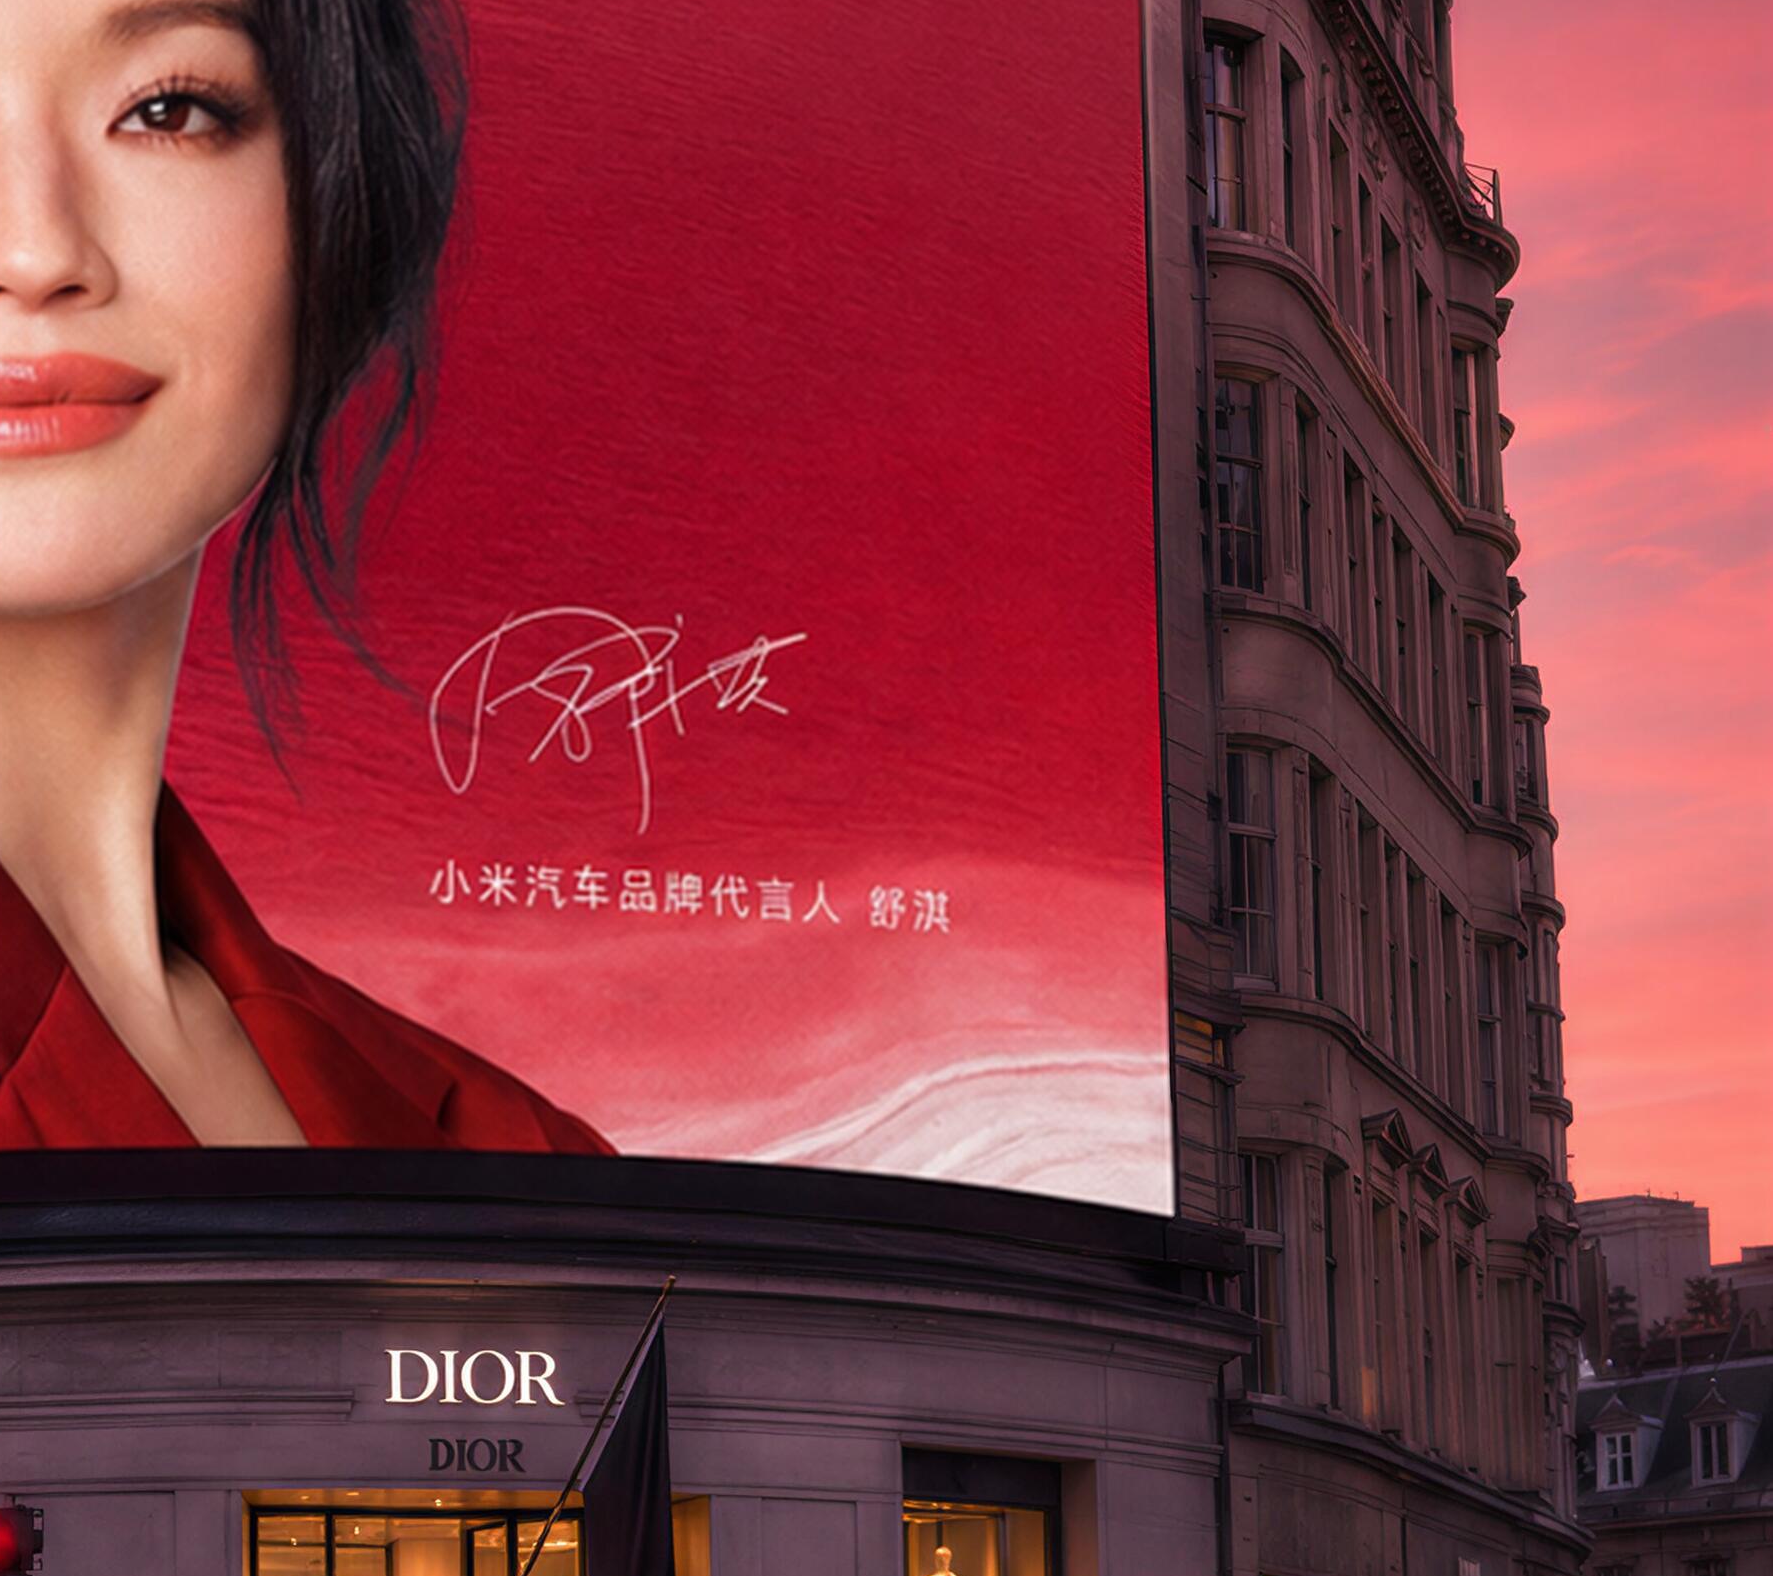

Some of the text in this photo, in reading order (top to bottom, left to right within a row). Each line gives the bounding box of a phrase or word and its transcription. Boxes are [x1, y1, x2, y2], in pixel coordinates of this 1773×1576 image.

[429, 859, 951, 933] 小米汽车品牌代言人 舒淇
[384, 1348, 566, 1406] DIOR
[428, 1437, 526, 1473] DIOR
